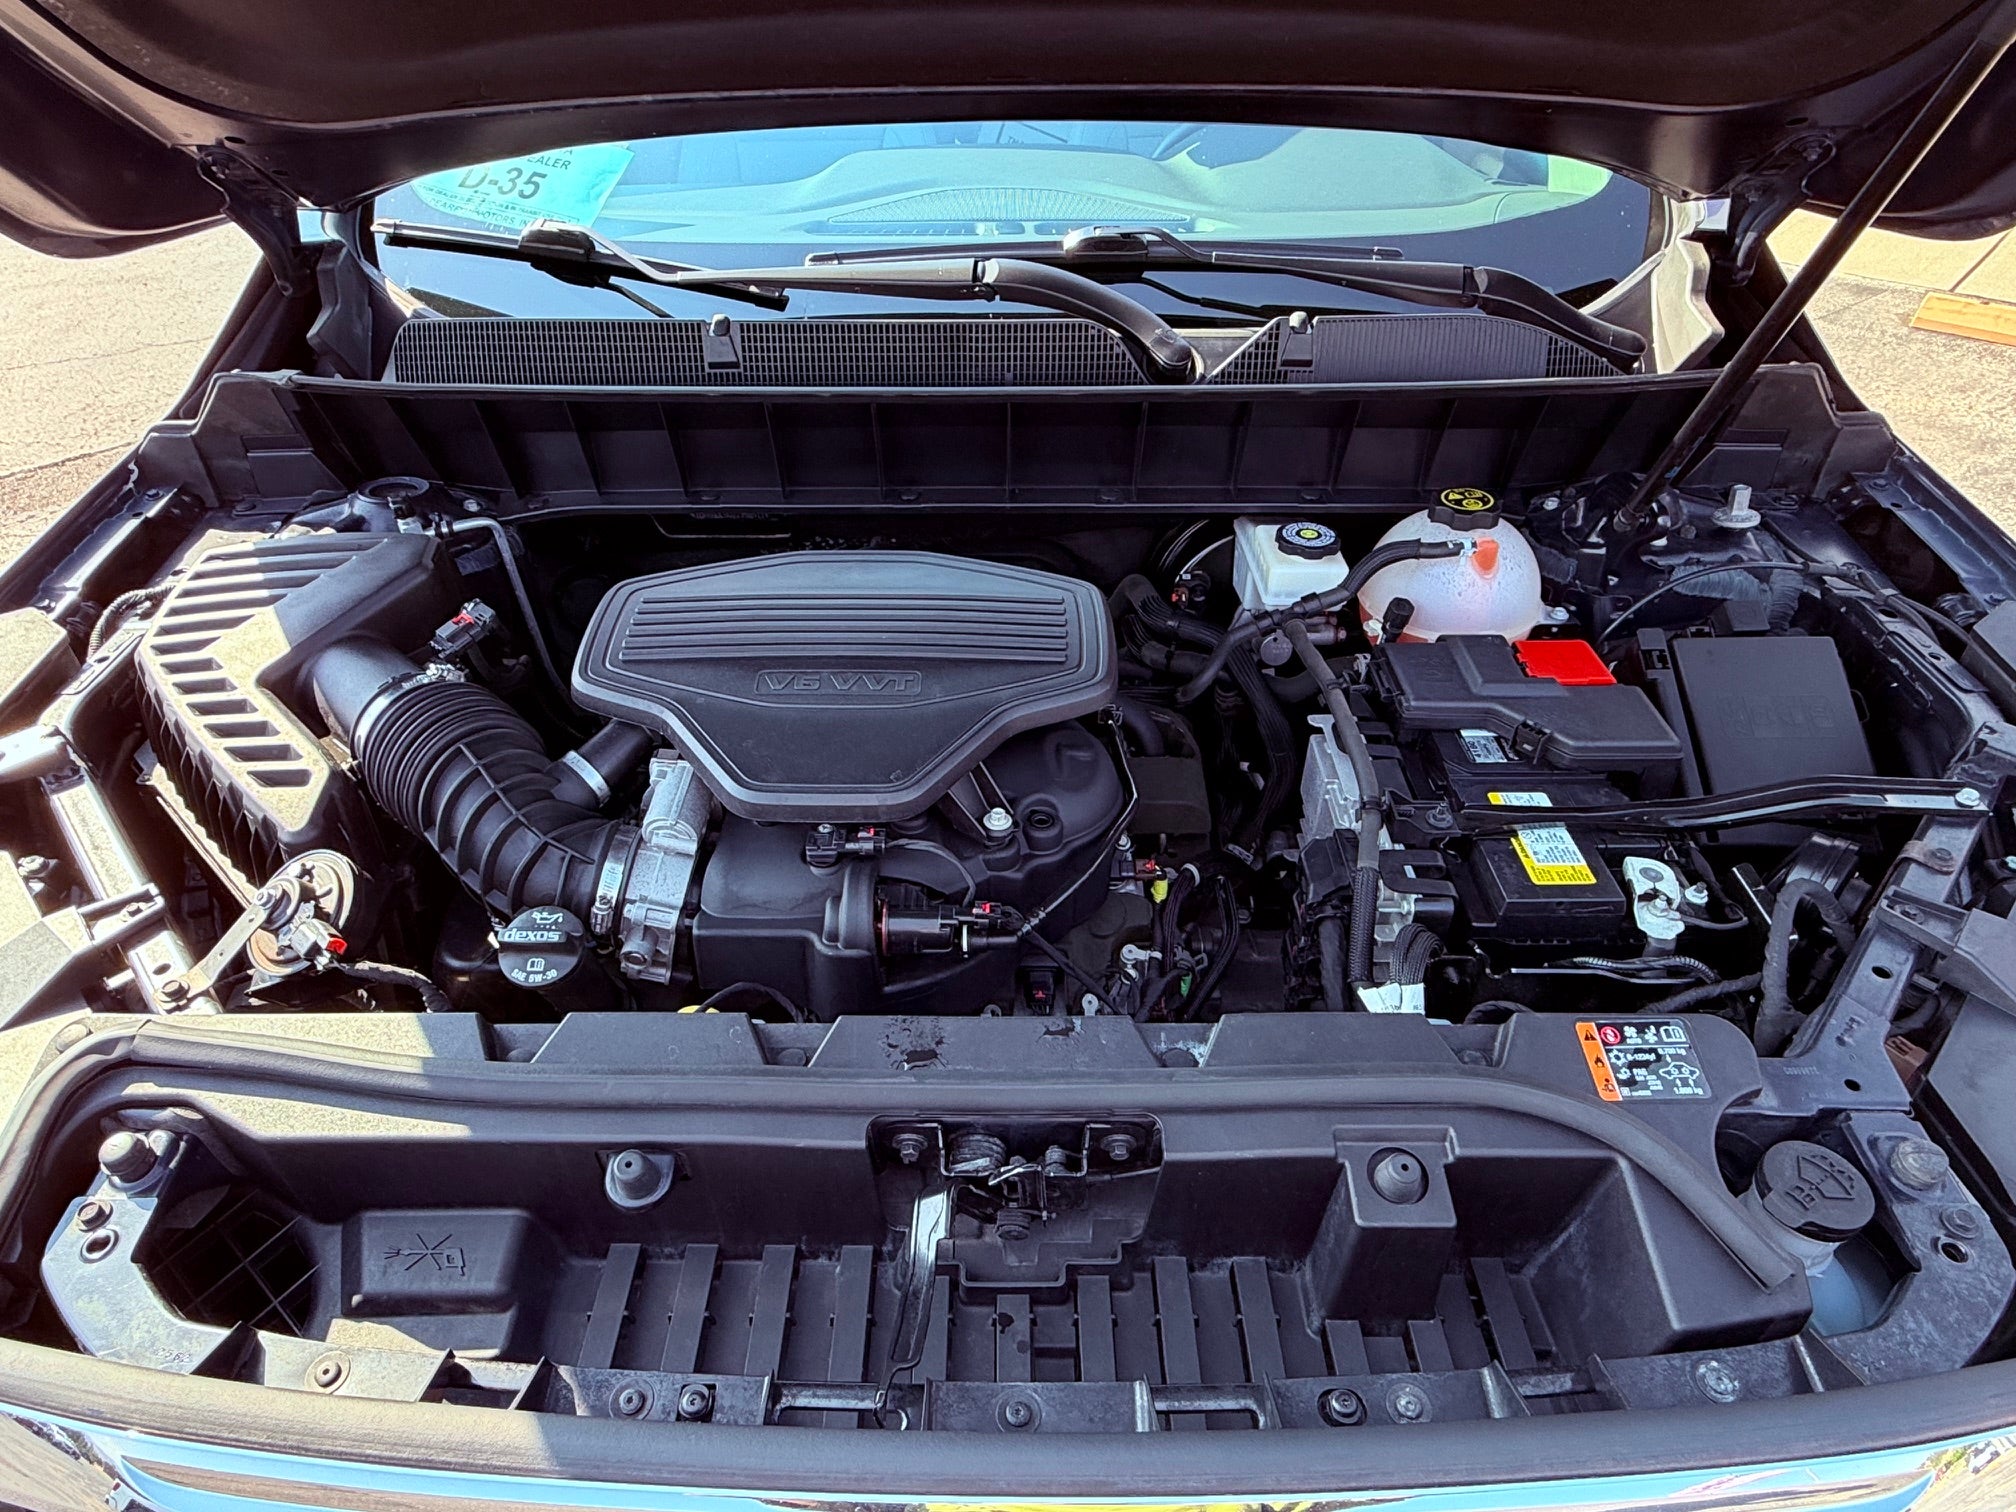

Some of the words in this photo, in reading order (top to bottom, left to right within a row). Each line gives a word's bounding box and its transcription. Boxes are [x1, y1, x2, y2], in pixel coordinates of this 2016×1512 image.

[526, 156, 572, 170] EALER
[457, 165, 548, 200] D-35
[764, 674, 821, 691] V6
[829, 674, 915, 691] VVT
[504, 928, 562, 941] dexos
[511, 968, 528, 981] SAE
[528, 968, 558, 983] 5W-30
